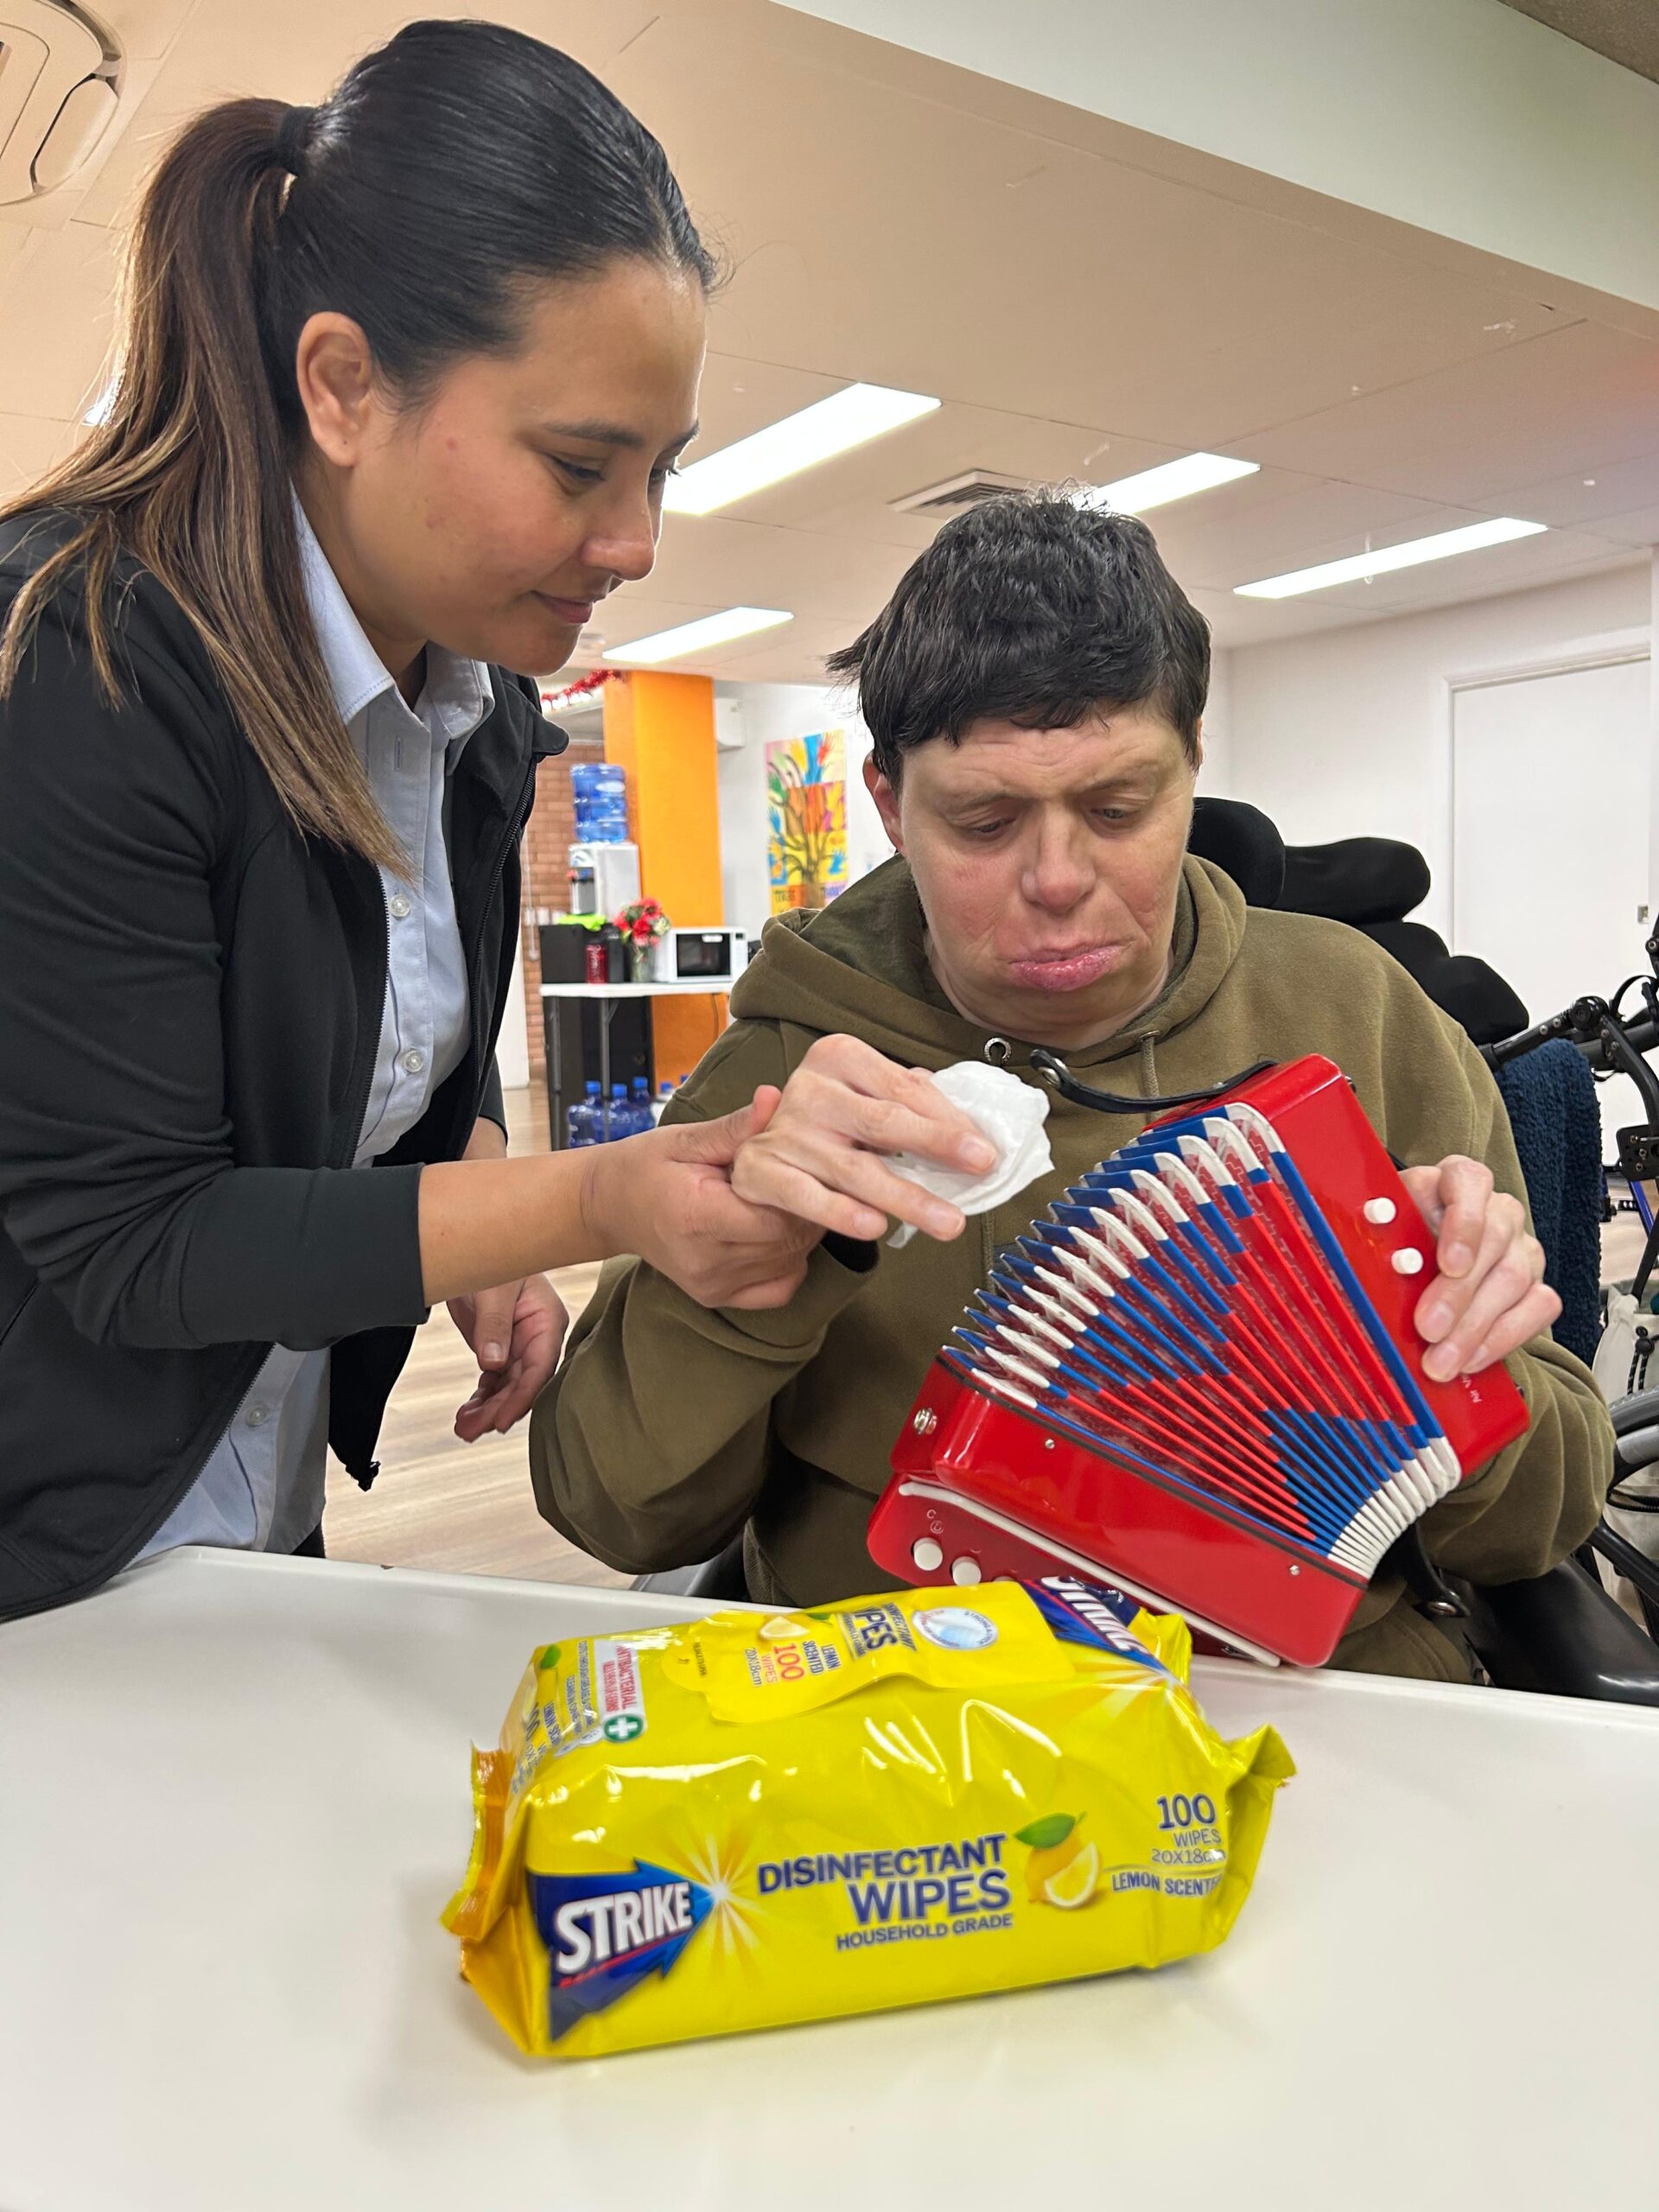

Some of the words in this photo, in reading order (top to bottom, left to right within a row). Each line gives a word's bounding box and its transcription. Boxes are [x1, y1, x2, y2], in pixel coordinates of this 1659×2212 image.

[926, 1509, 937, 1519] C
[762, 1654, 778, 1683] WIPES
[774, 1643, 805, 1681] 100
[803, 1640, 824, 1674] SCENTED
[821, 1644, 841, 1669] LEMON
[616, 1645, 637, 1709] ANTIBACTERIAL
[1156, 1793, 1216, 1829] 100
[1173, 1828, 1222, 1847] WIPES
[757, 1832, 1007, 1894] DISINFECTANT
[847, 1869, 1011, 1926] WIPES
[1111, 1872, 1160, 1891] LEMON
[1164, 1873, 1224, 1896] SCENTE
[554, 1881, 692, 1974] STRIKE
[836, 1923, 948, 1951] HOUSEHOLD
[952, 1912, 1014, 1936] GRADE
